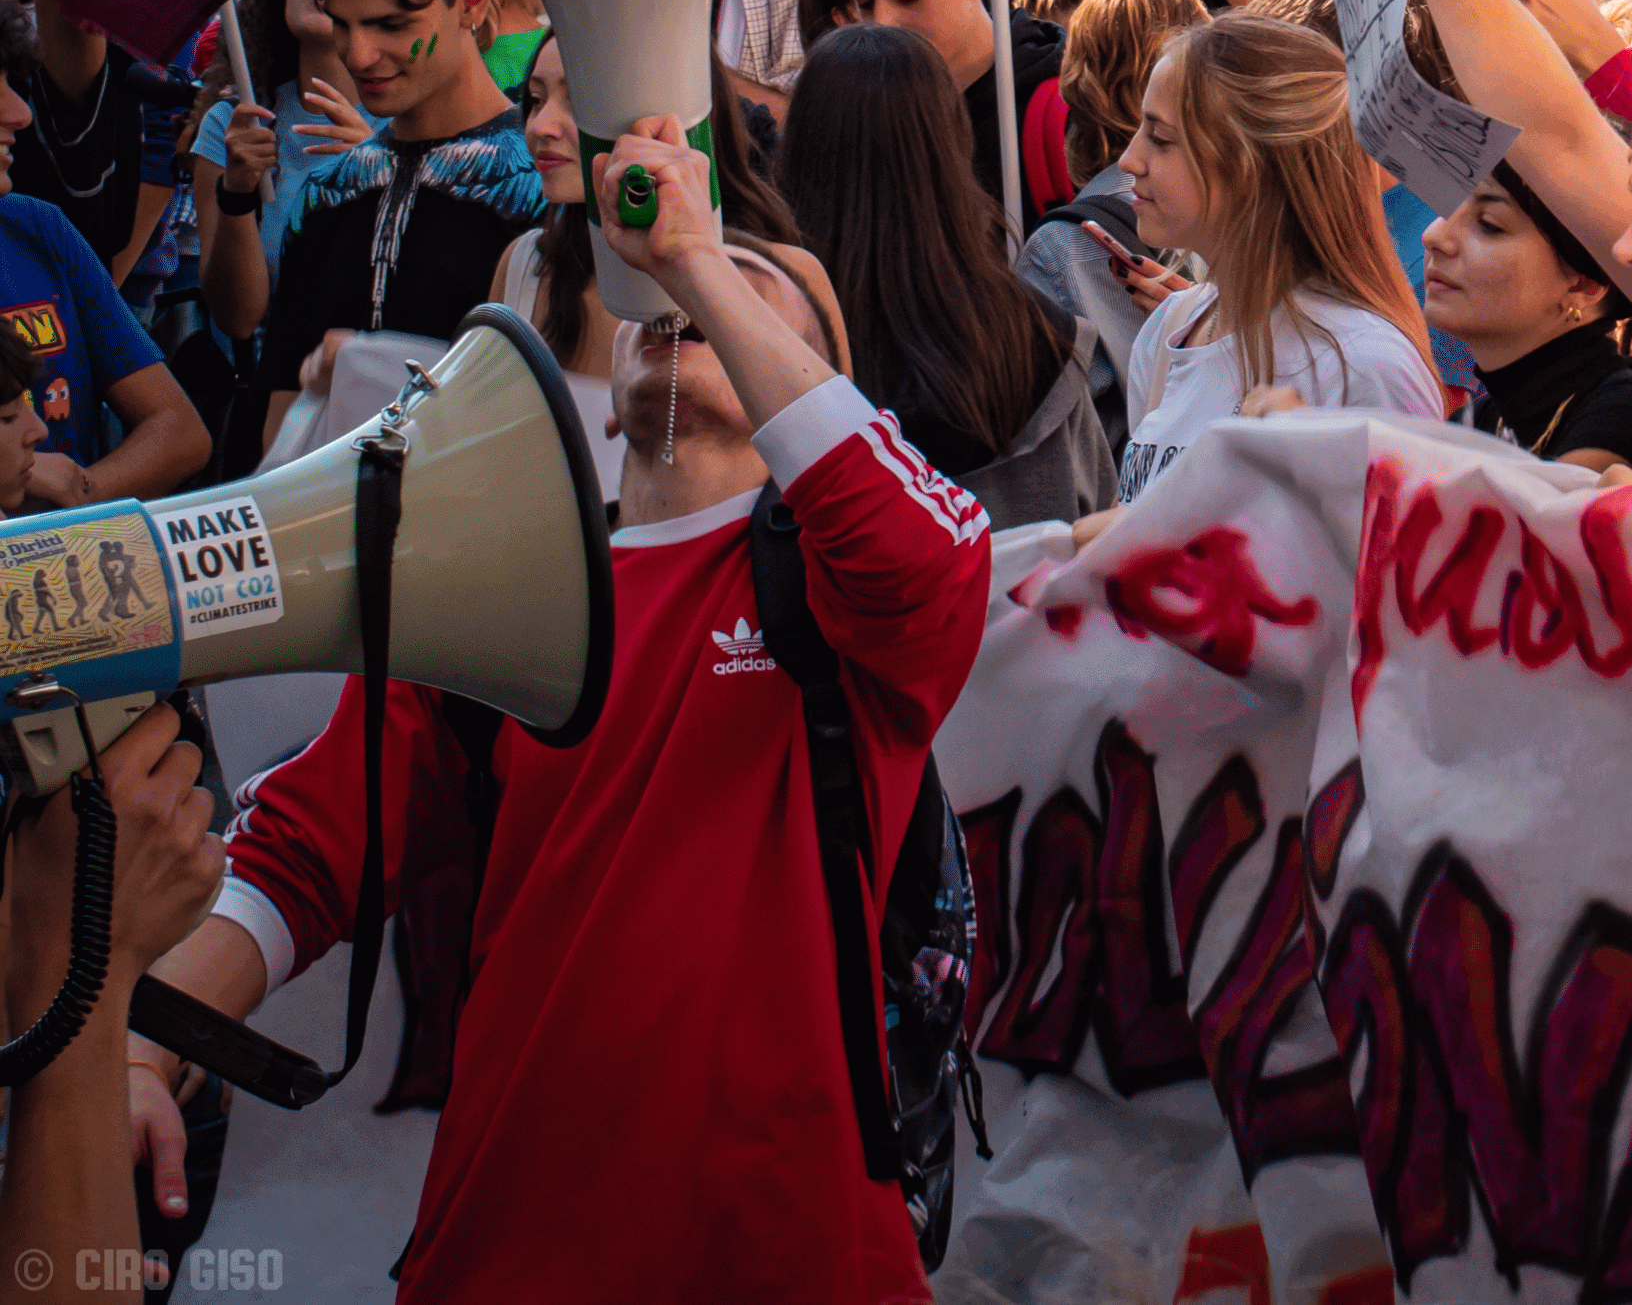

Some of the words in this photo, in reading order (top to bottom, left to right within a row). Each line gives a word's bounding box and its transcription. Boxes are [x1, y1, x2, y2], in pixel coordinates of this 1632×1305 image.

[166, 505, 260, 545] MAKE
[177, 535, 270, 583] LOVE
[186, 584, 225, 610] NOT
[236, 574, 275, 599] CO2
[190, 597, 278, 624] #CLIMATESTRIKE
[713, 656, 776, 675] adidas
